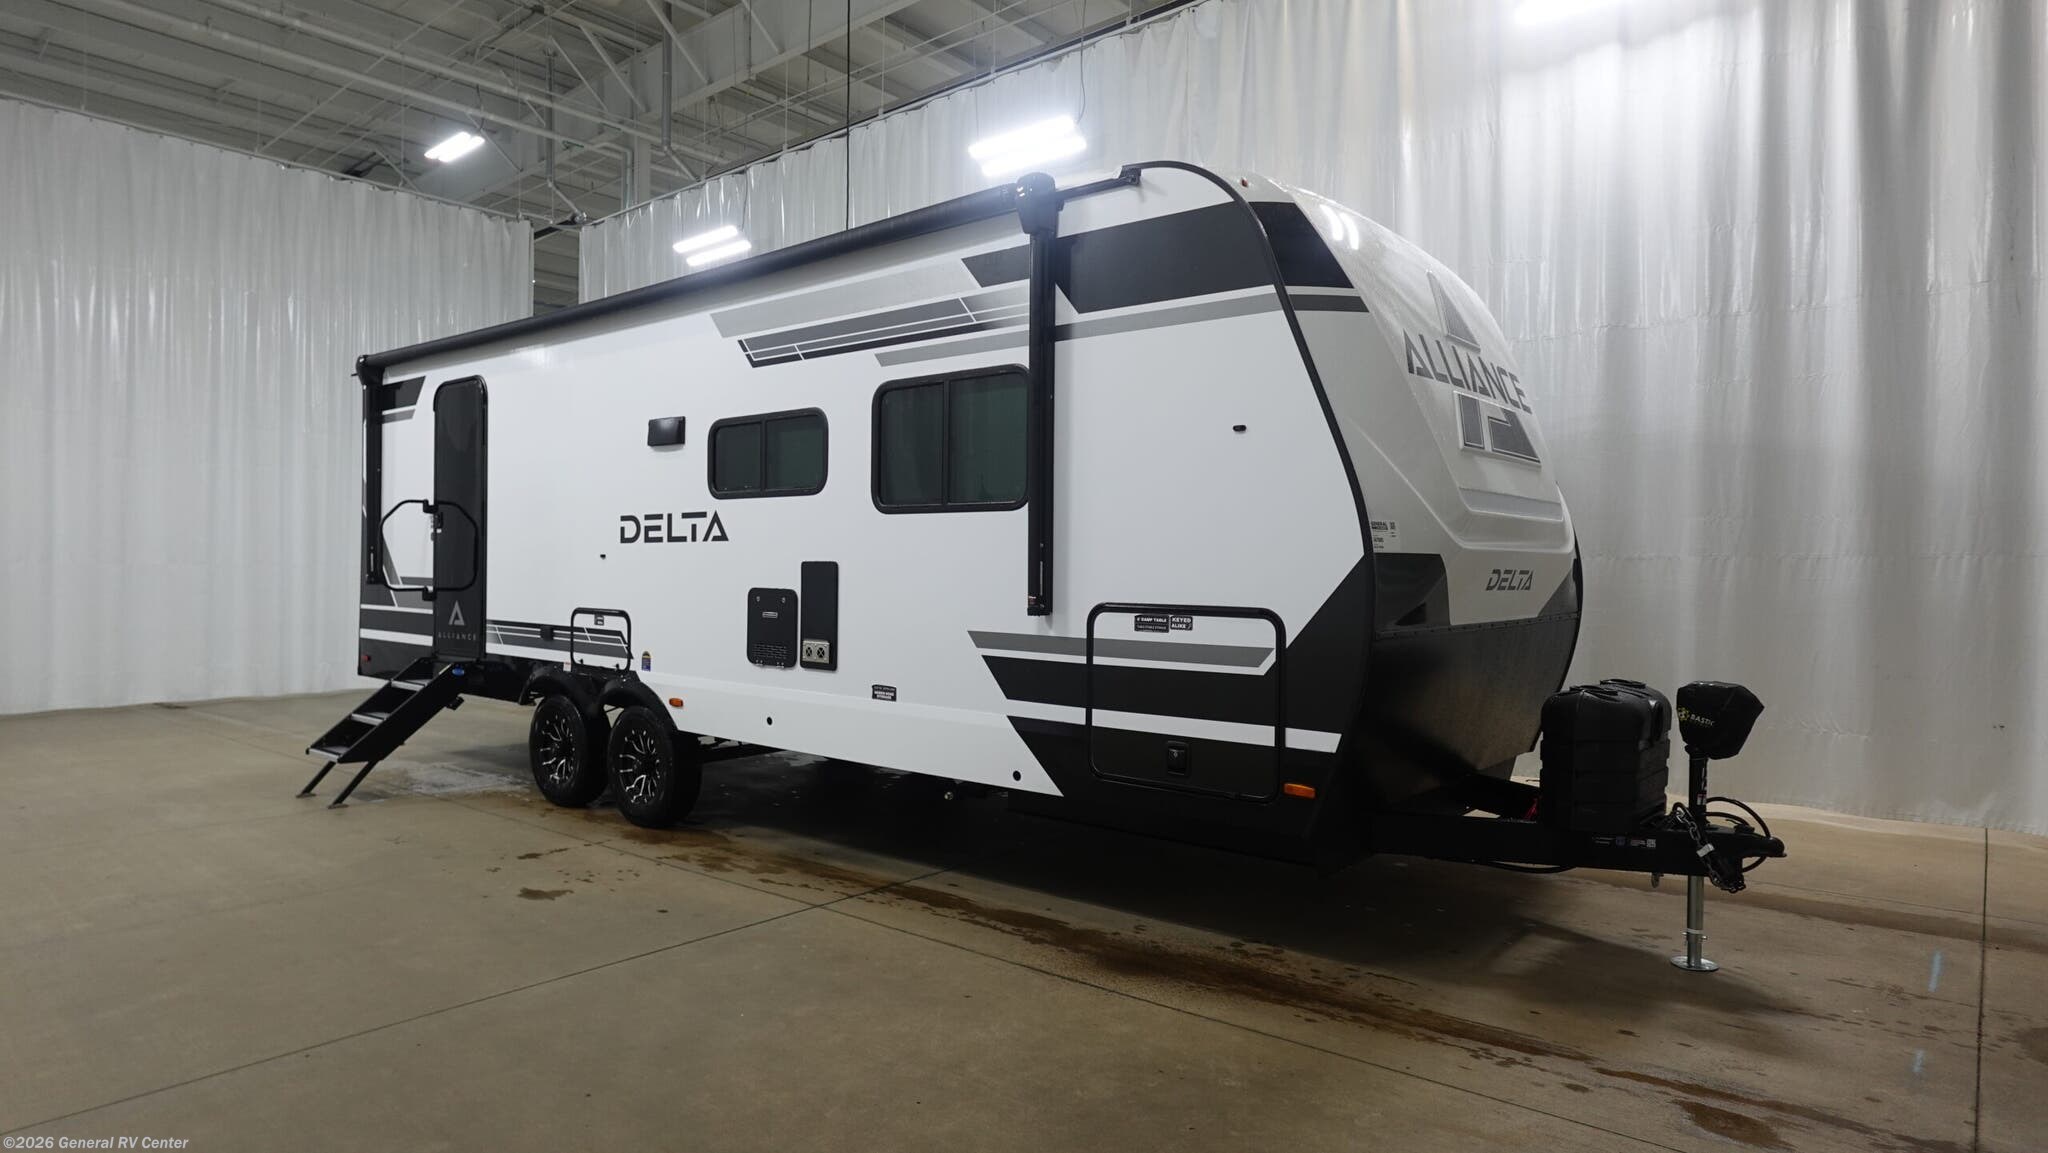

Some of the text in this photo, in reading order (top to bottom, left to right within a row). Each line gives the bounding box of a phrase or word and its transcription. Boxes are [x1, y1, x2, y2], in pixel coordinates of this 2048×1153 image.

[1403, 328, 1533, 415] ALLIANCE
[620, 510, 730, 544] DELTA
[1485, 568, 1535, 591] DELTA
